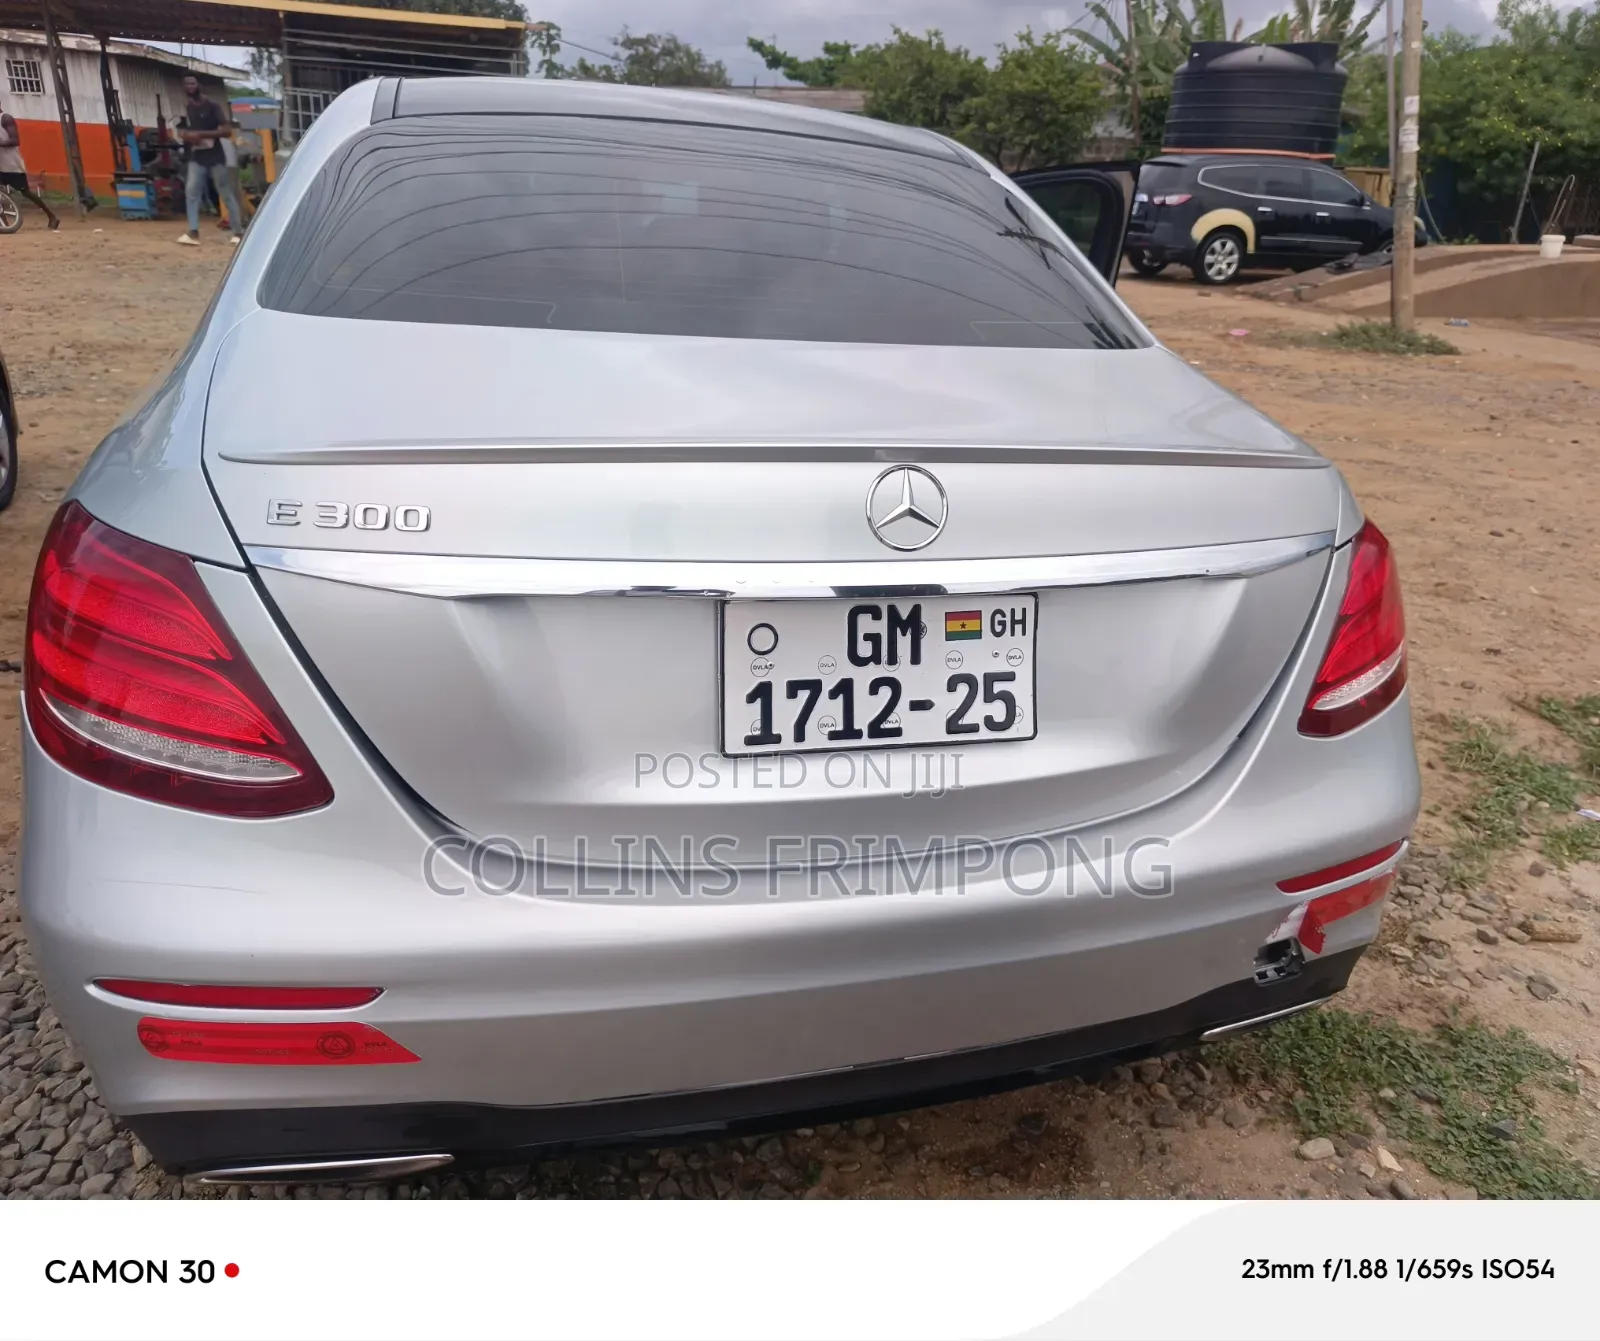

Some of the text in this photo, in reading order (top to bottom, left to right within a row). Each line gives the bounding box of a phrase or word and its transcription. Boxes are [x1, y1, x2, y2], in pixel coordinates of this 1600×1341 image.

[266, 499, 432, 532] E 300
[847, 604, 922, 667] GM
[990, 607, 1027, 637] GH
[744, 671, 1016, 746] 1712-25
